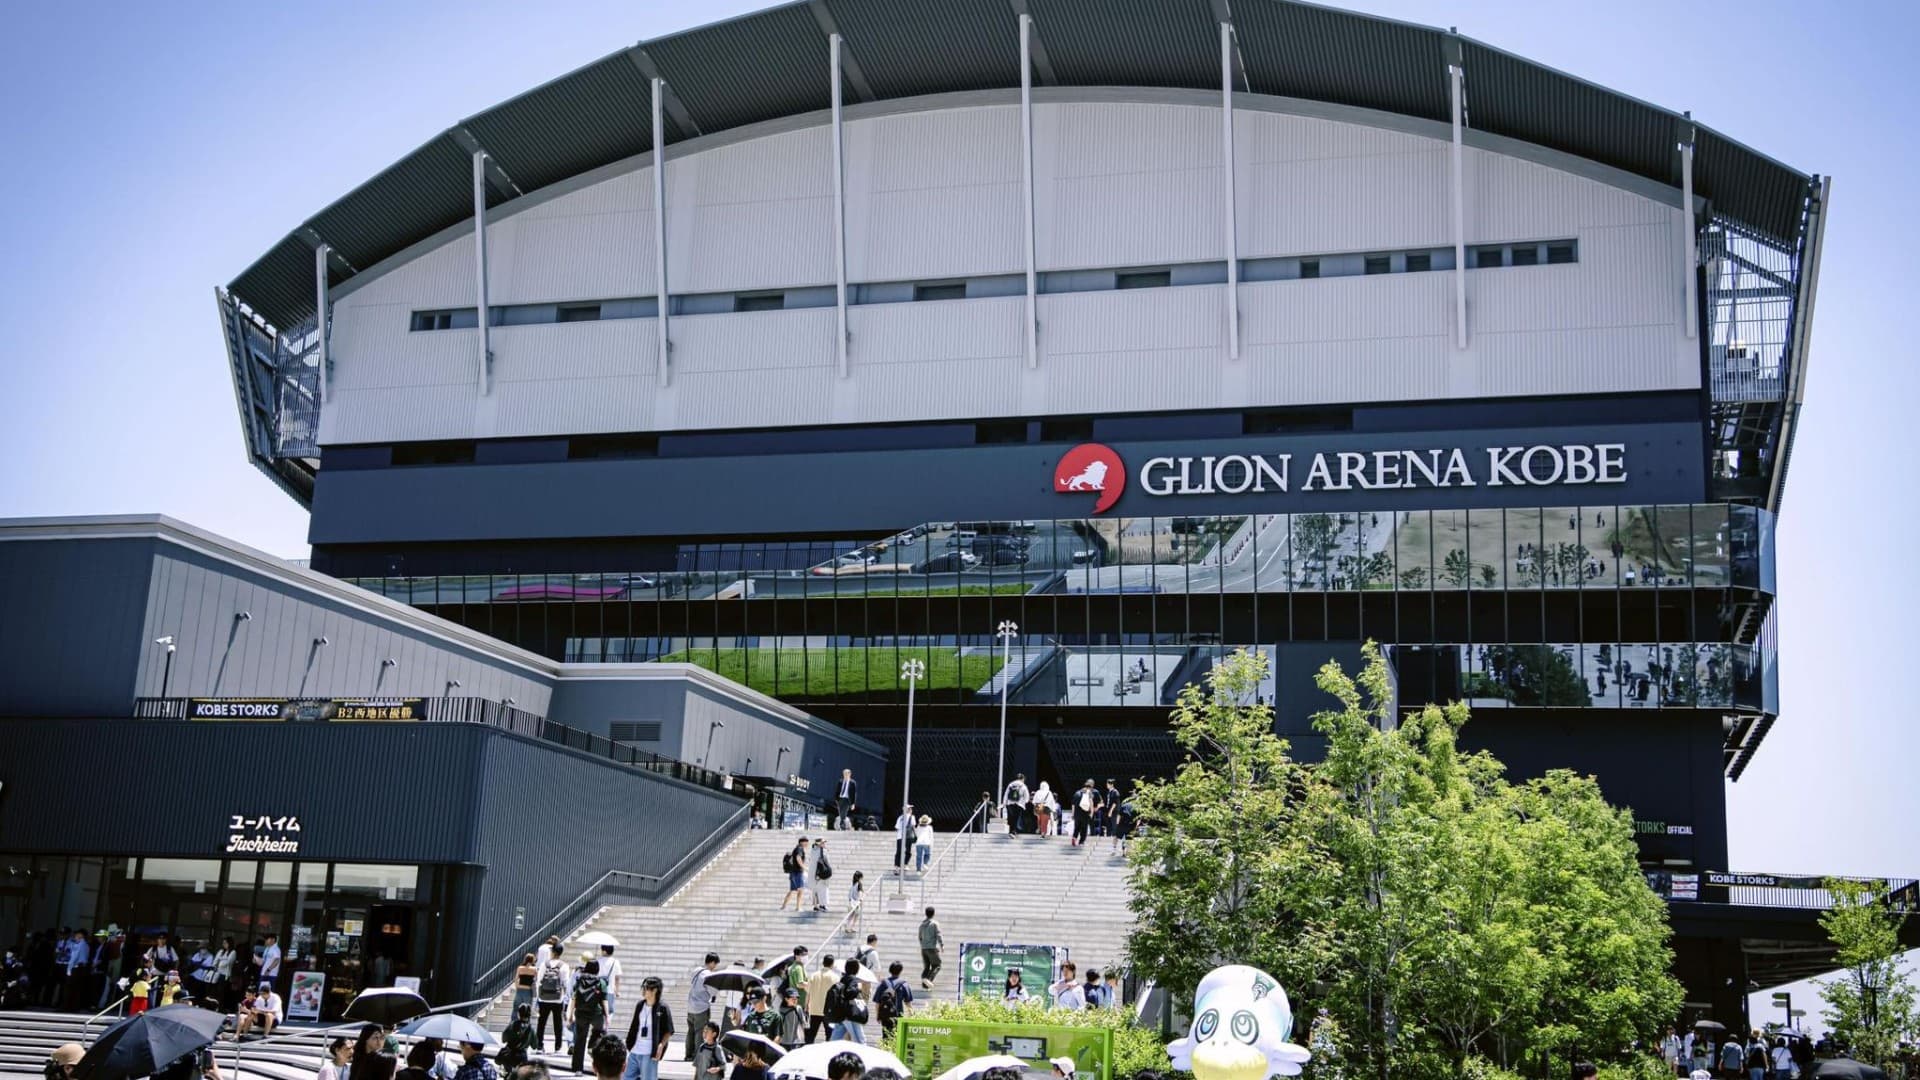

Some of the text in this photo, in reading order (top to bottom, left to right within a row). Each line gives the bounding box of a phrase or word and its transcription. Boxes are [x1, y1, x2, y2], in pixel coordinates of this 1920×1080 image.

[1140, 443, 1628, 496] GLION ARENA KOBE
[196, 704, 279, 716] KOBE STORKS
[229, 815, 300, 832] ユーハイム
[1633, 821, 1693, 835] TORKS OFFICIAL
[226, 834, 298, 853] Juchheim
[1709, 874, 1775, 885] KOBE STORKS
[935, 1027, 952, 1036] MAP
